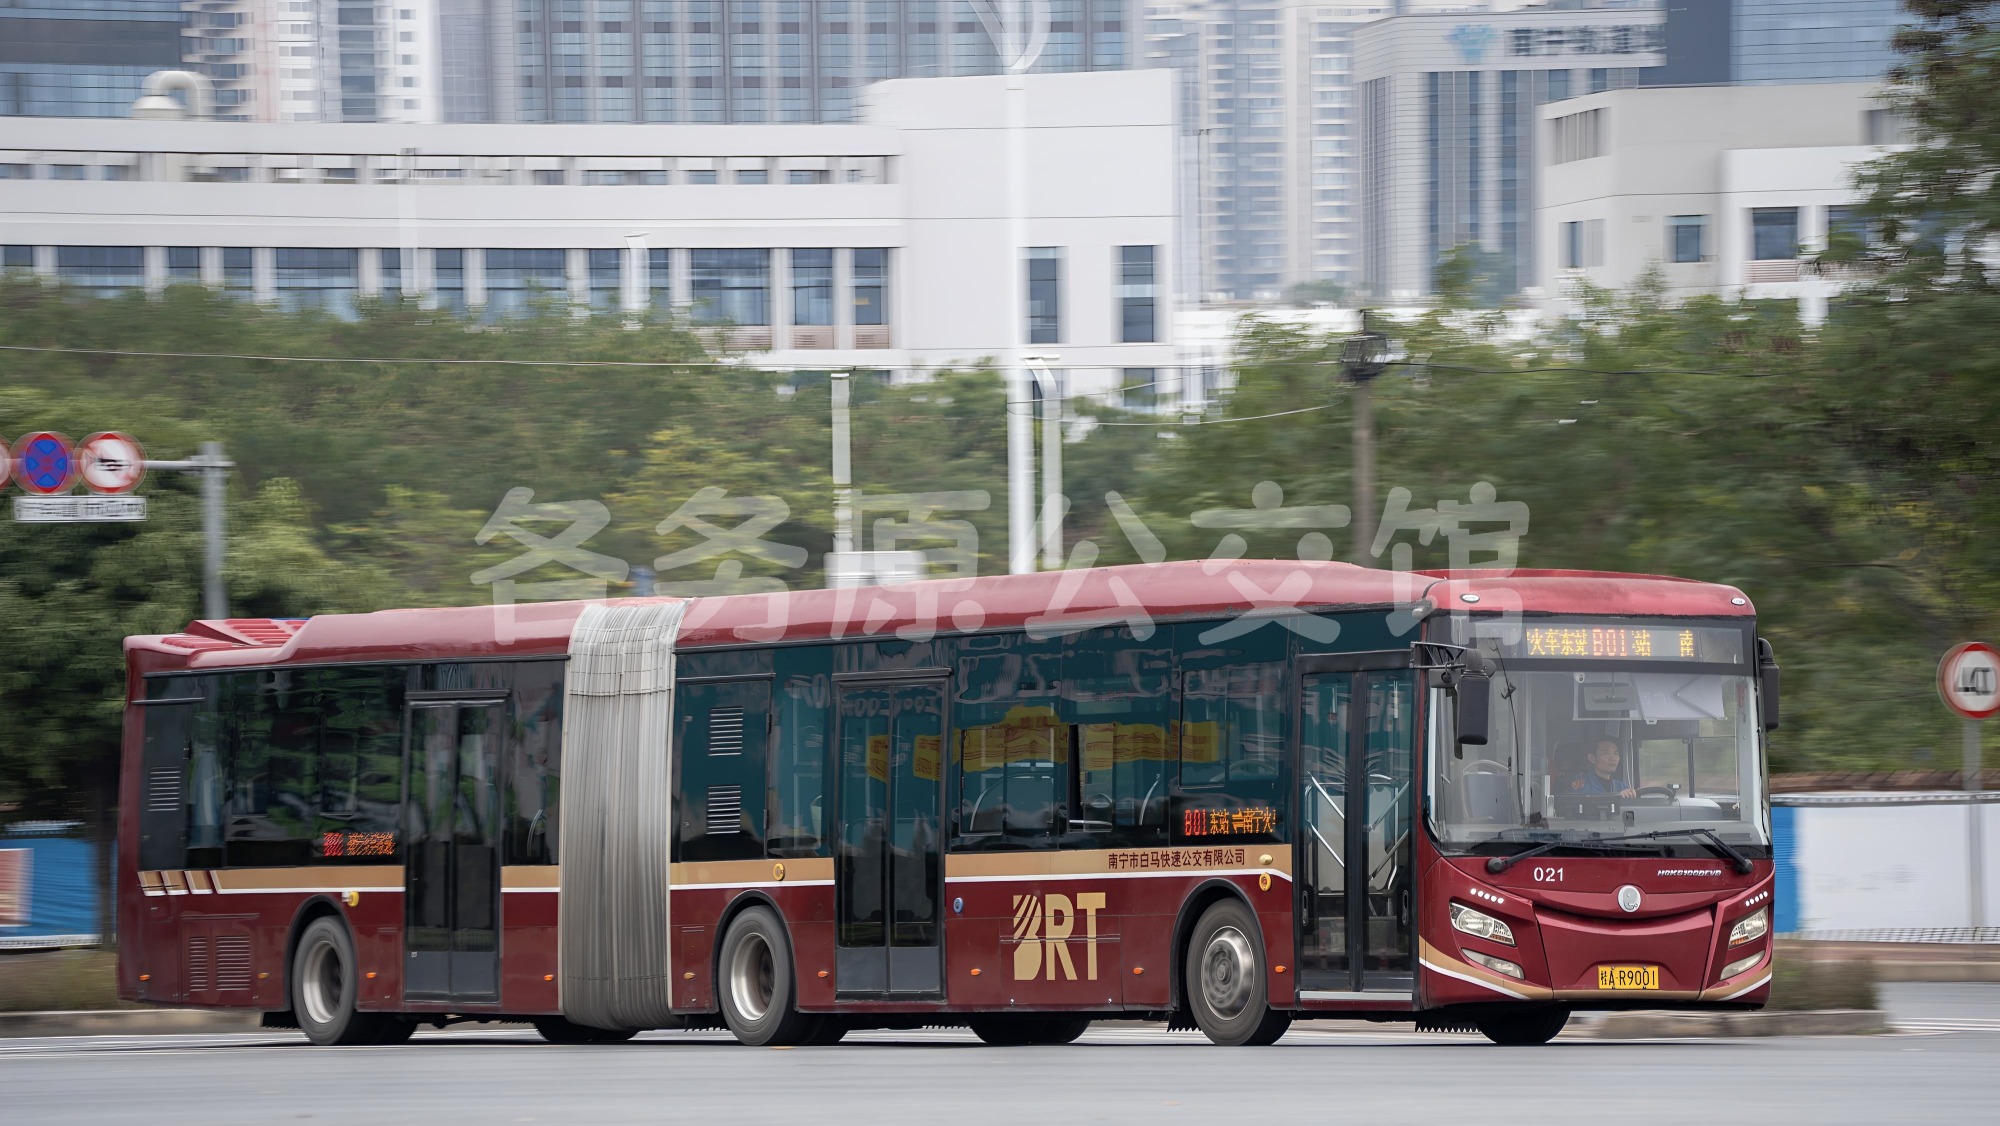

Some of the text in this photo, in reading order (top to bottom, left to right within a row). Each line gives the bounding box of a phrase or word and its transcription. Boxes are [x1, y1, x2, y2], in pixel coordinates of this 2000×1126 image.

[1527, 628, 1588, 656] 火车东站
[1108, 849, 1245, 869] 南宁市白马快速公交有限公司
[1533, 867, 1564, 882] 021
[1012, 891, 1106, 981] BRT
